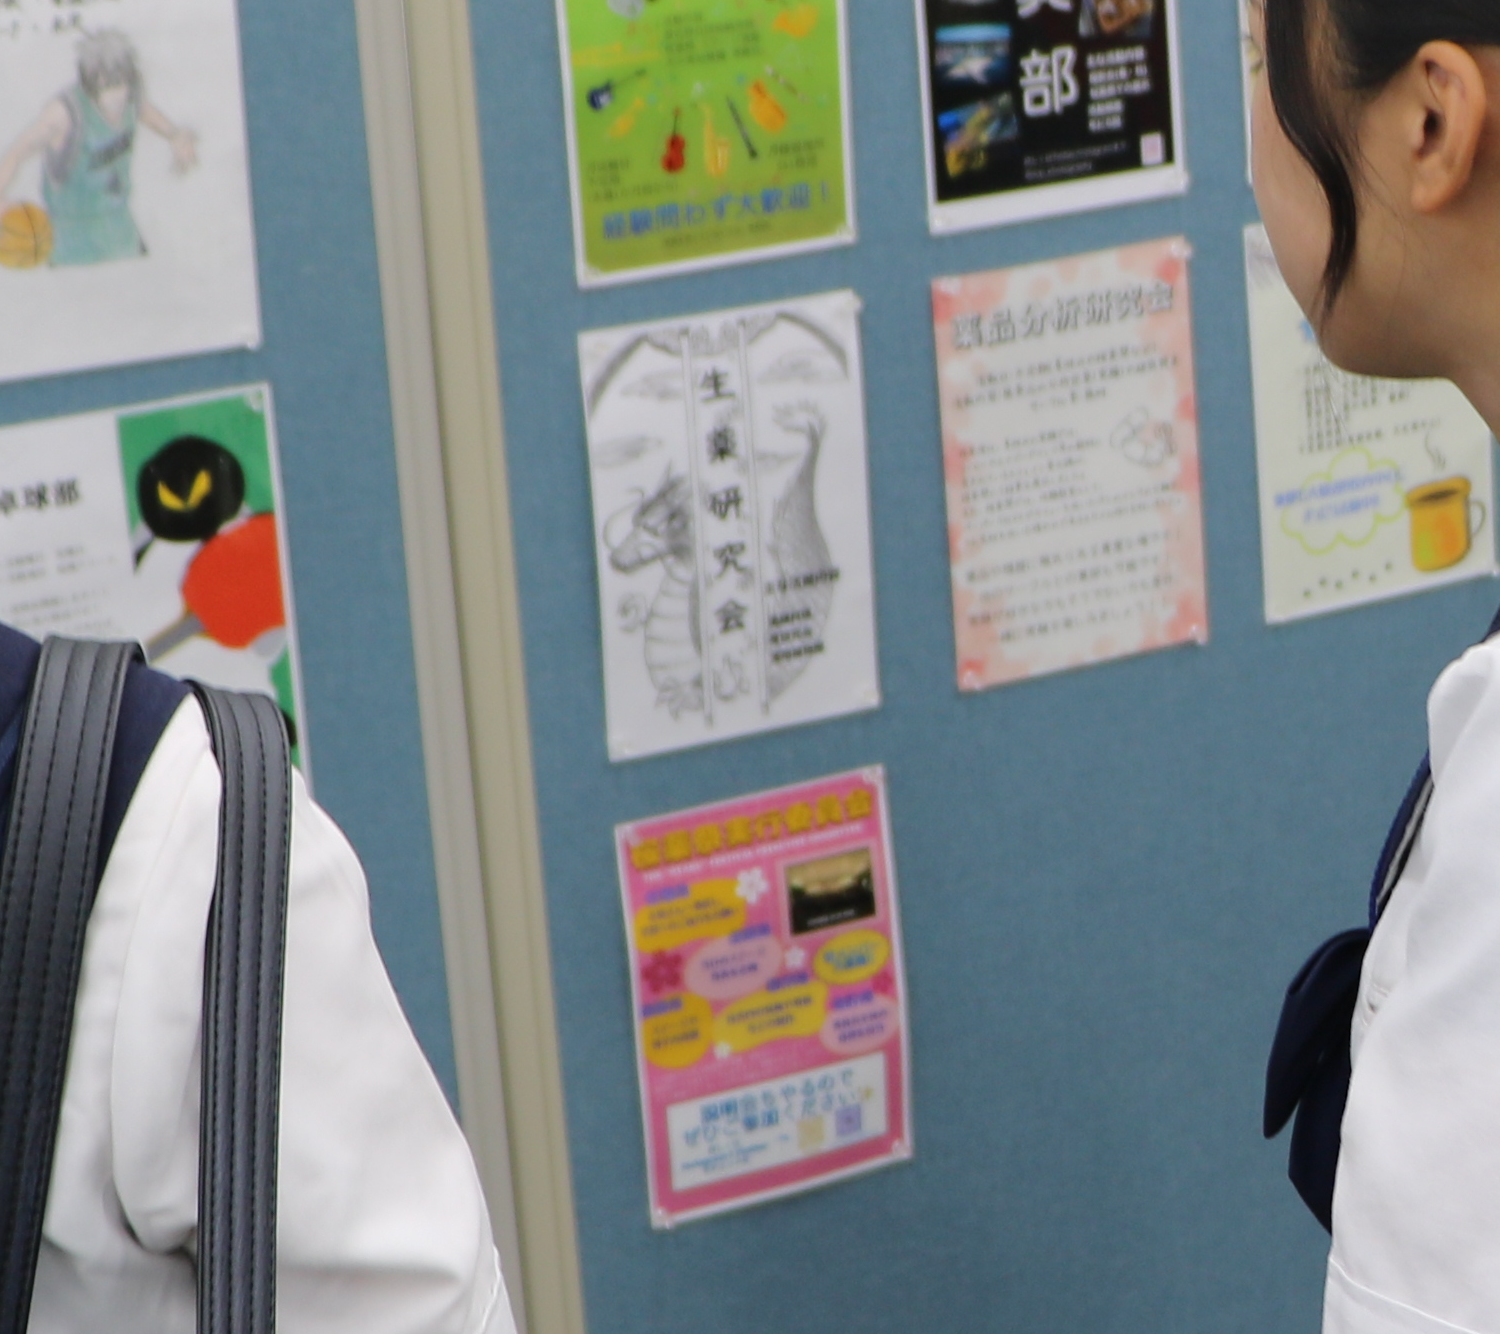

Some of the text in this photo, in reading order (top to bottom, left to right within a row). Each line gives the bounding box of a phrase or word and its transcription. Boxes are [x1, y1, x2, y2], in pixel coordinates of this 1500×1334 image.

[700, 368, 748, 634] 生薬研究会
